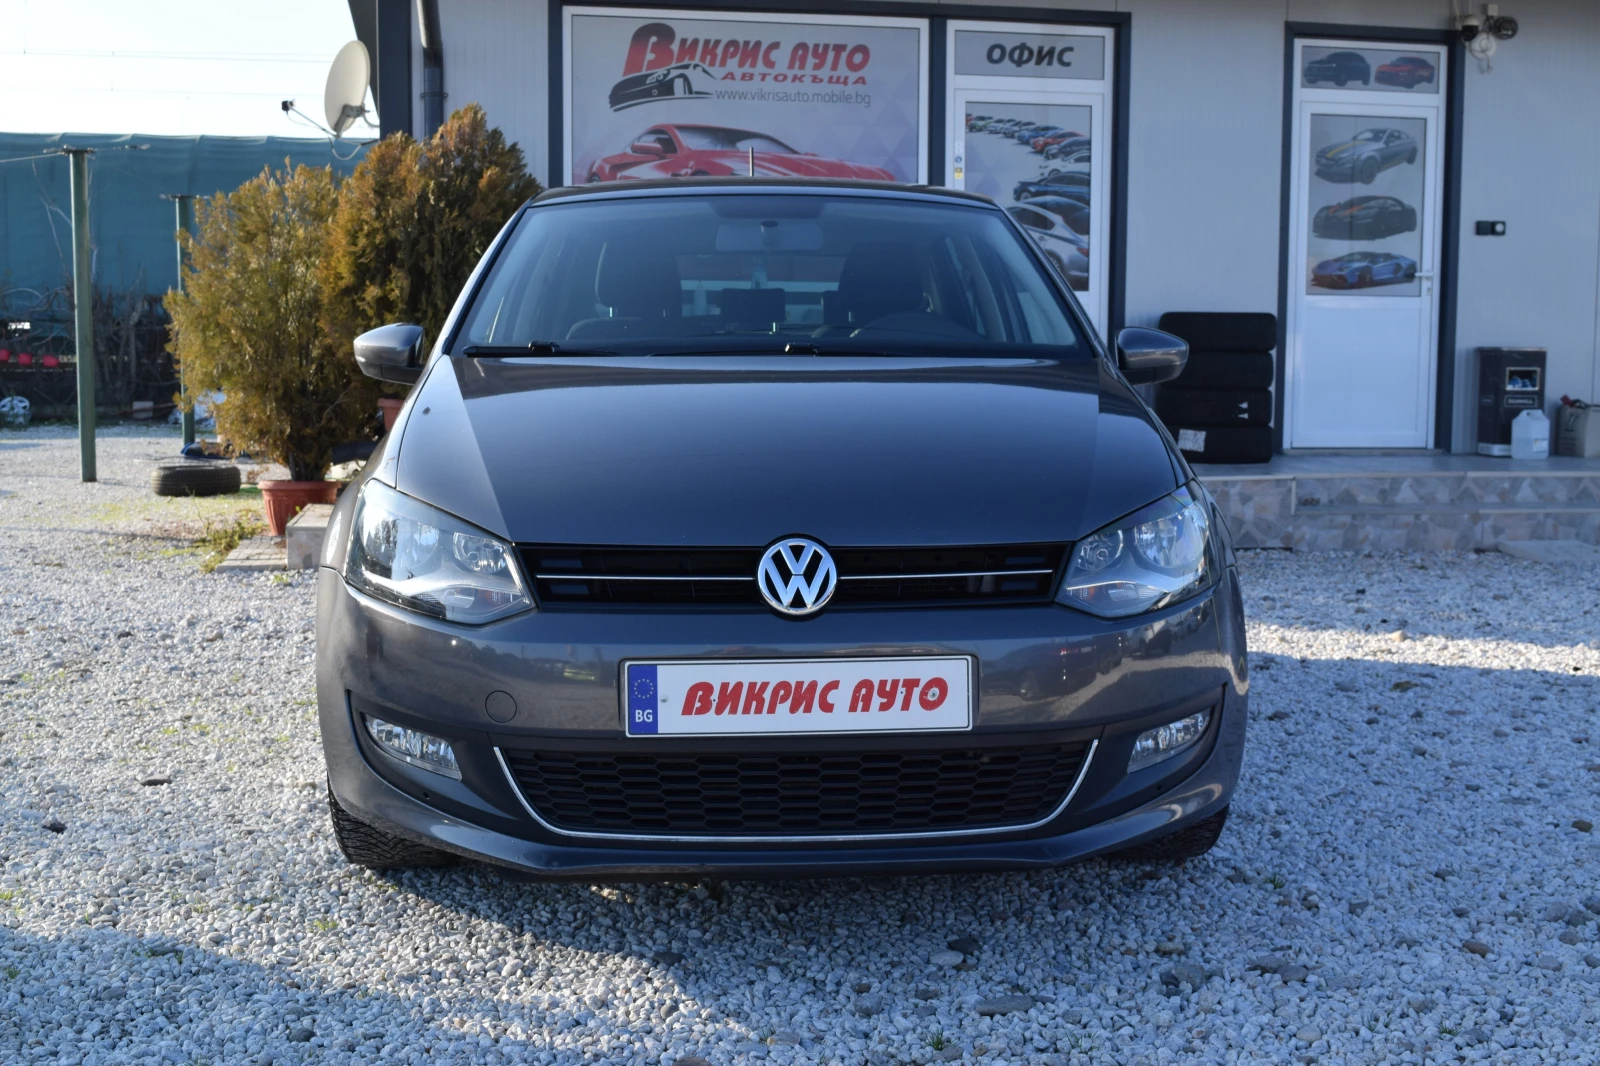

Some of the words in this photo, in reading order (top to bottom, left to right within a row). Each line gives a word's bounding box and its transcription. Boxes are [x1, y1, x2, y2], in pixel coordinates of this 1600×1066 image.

[622, 22, 782, 77] ВИКРИС
[787, 41, 871, 73] АУТО
[986, 42, 1074, 68] ОФИС
[720, 71, 868, 87] АВТОКЪЩА
[715, 87, 871, 108] www.vikrisauto.mobile.bg
[681, 679, 840, 716] ВИКРИС
[848, 676, 949, 713] АУТО
[635, 709, 653, 723] BG
